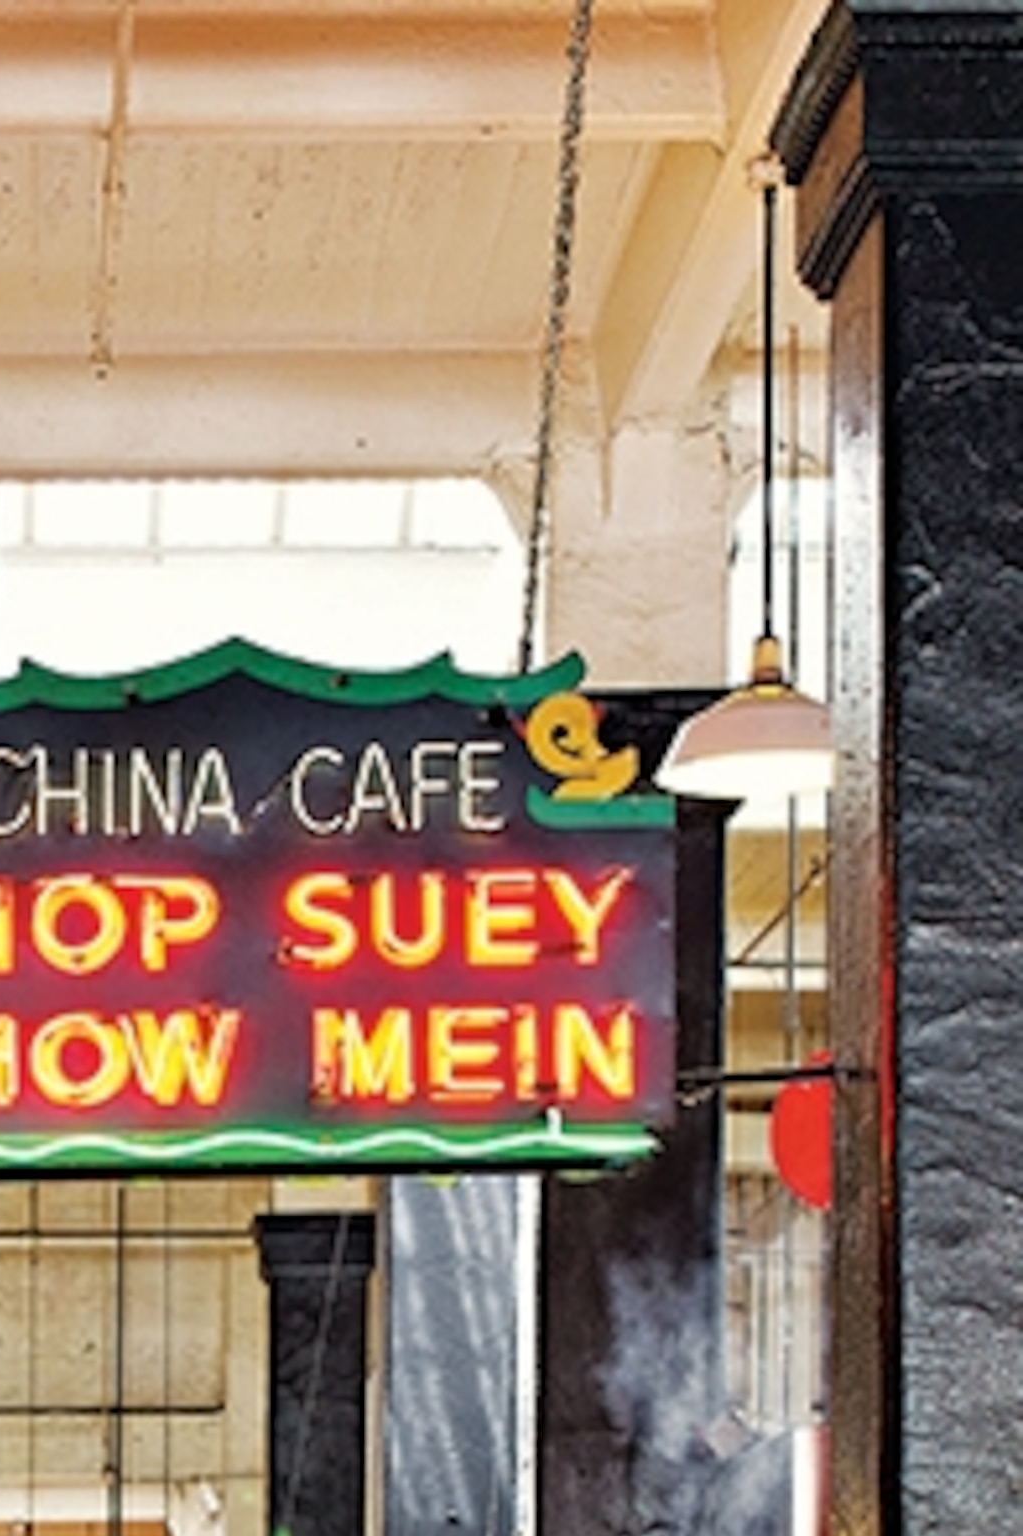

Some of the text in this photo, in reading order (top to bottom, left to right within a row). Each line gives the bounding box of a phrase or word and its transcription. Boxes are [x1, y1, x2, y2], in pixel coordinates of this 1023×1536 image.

[288, 741, 507, 835] CAFE
[279, 867, 636, 969] SUEY
[310, 1002, 637, 1106] MEIN
